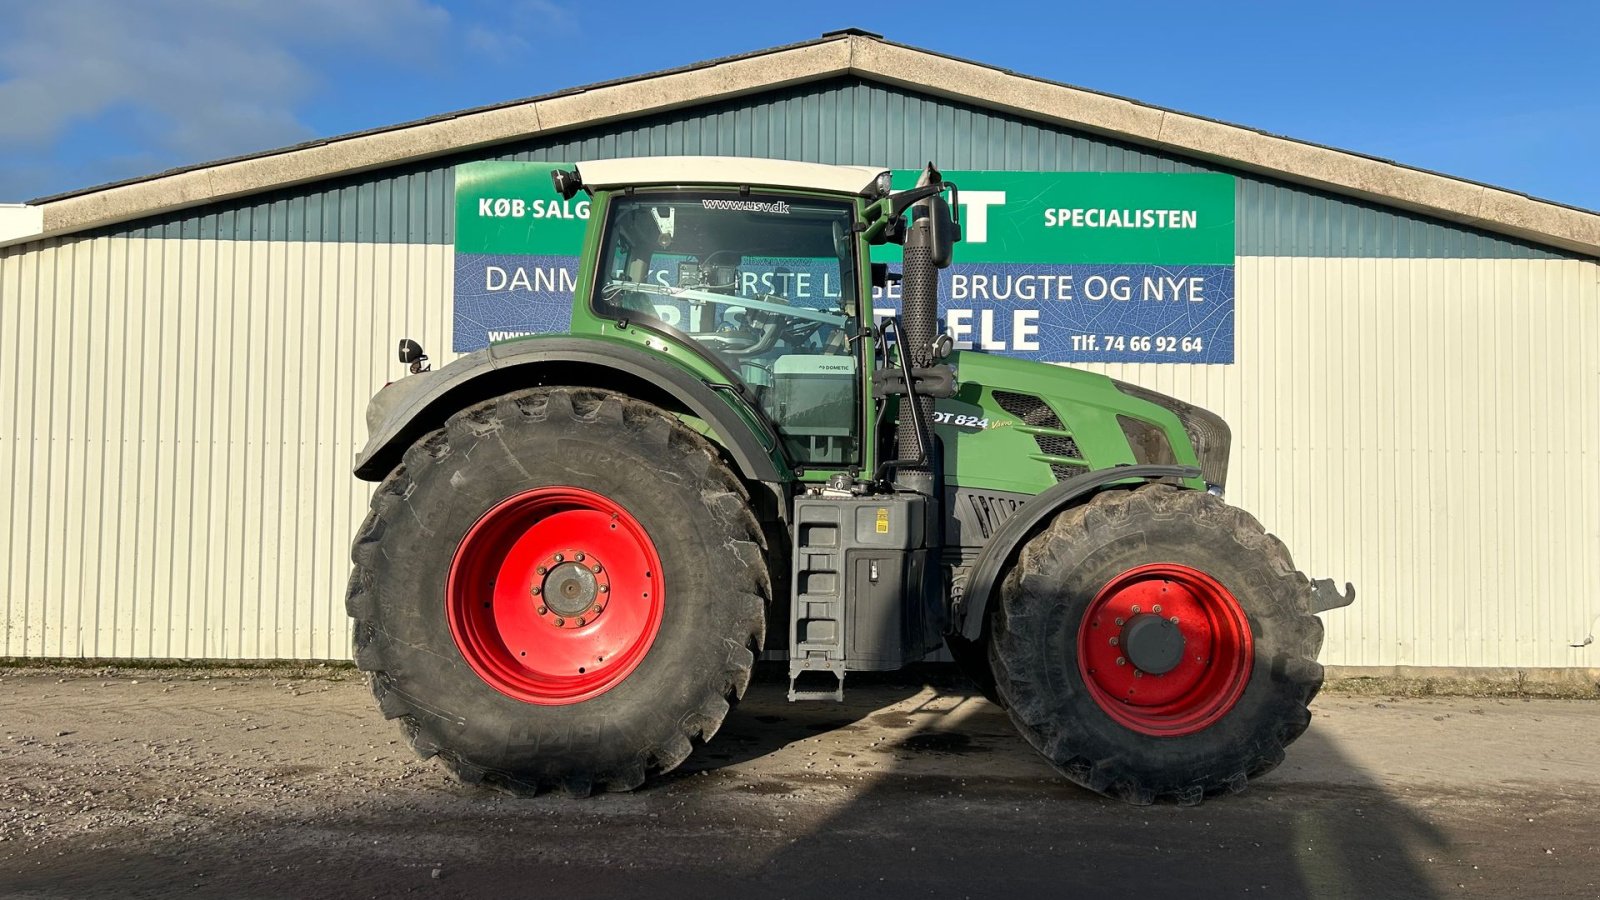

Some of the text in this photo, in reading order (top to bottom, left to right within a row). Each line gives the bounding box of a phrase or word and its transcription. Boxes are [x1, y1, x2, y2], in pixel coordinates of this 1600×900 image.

[702, 200, 790, 214] www.usv.dk
[1044, 208, 1197, 229] SPECIALISTEN
[952, 275, 1073, 300] BRUGTE
[1084, 275, 1131, 301] OG
[1143, 277, 1204, 302] NYE
[1071, 335, 1100, 351] Tlf.
[1104, 336, 1125, 351] 74
[1130, 336, 1151, 352] 66
[1156, 336, 1177, 352] 92
[1182, 337, 1203, 352] 64
[955, 414, 989, 430] 824
